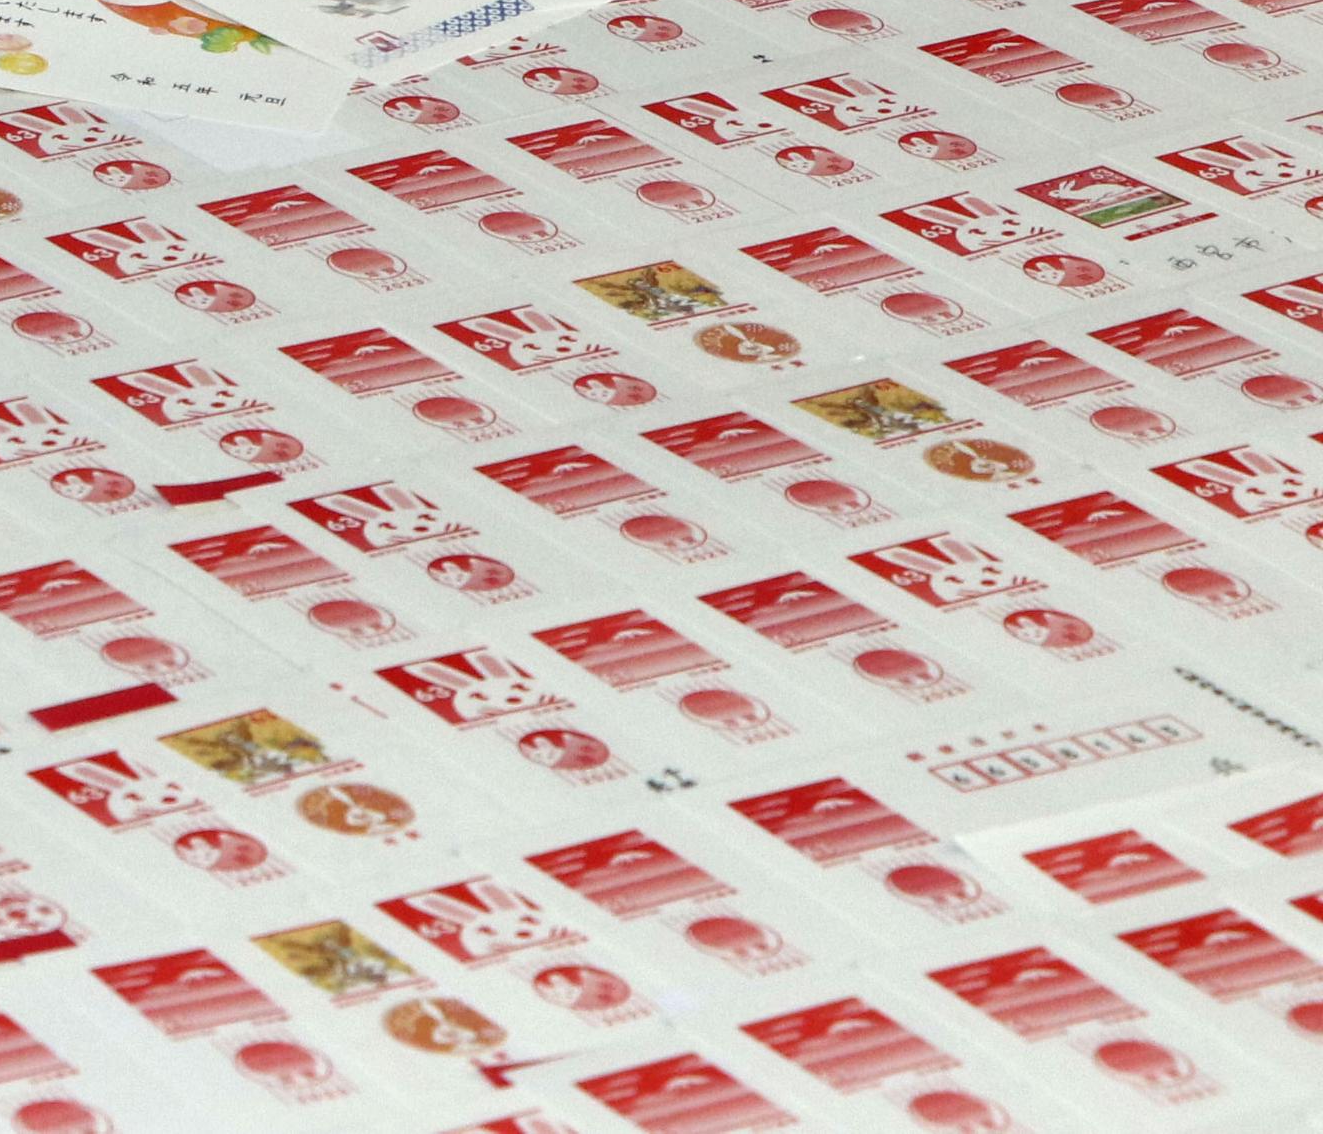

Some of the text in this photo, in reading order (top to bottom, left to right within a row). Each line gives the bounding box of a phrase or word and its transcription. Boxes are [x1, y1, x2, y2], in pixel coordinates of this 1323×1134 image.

[111, 72, 287, 107] 令和五年 元旦
[797, 101, 830, 117] 63
[680, 114, 713, 131] 63
[1198, 167, 1230, 179] 63
[918, 223, 952, 241] 63
[84, 247, 116, 264] 63
[125, 391, 160, 407] 63
